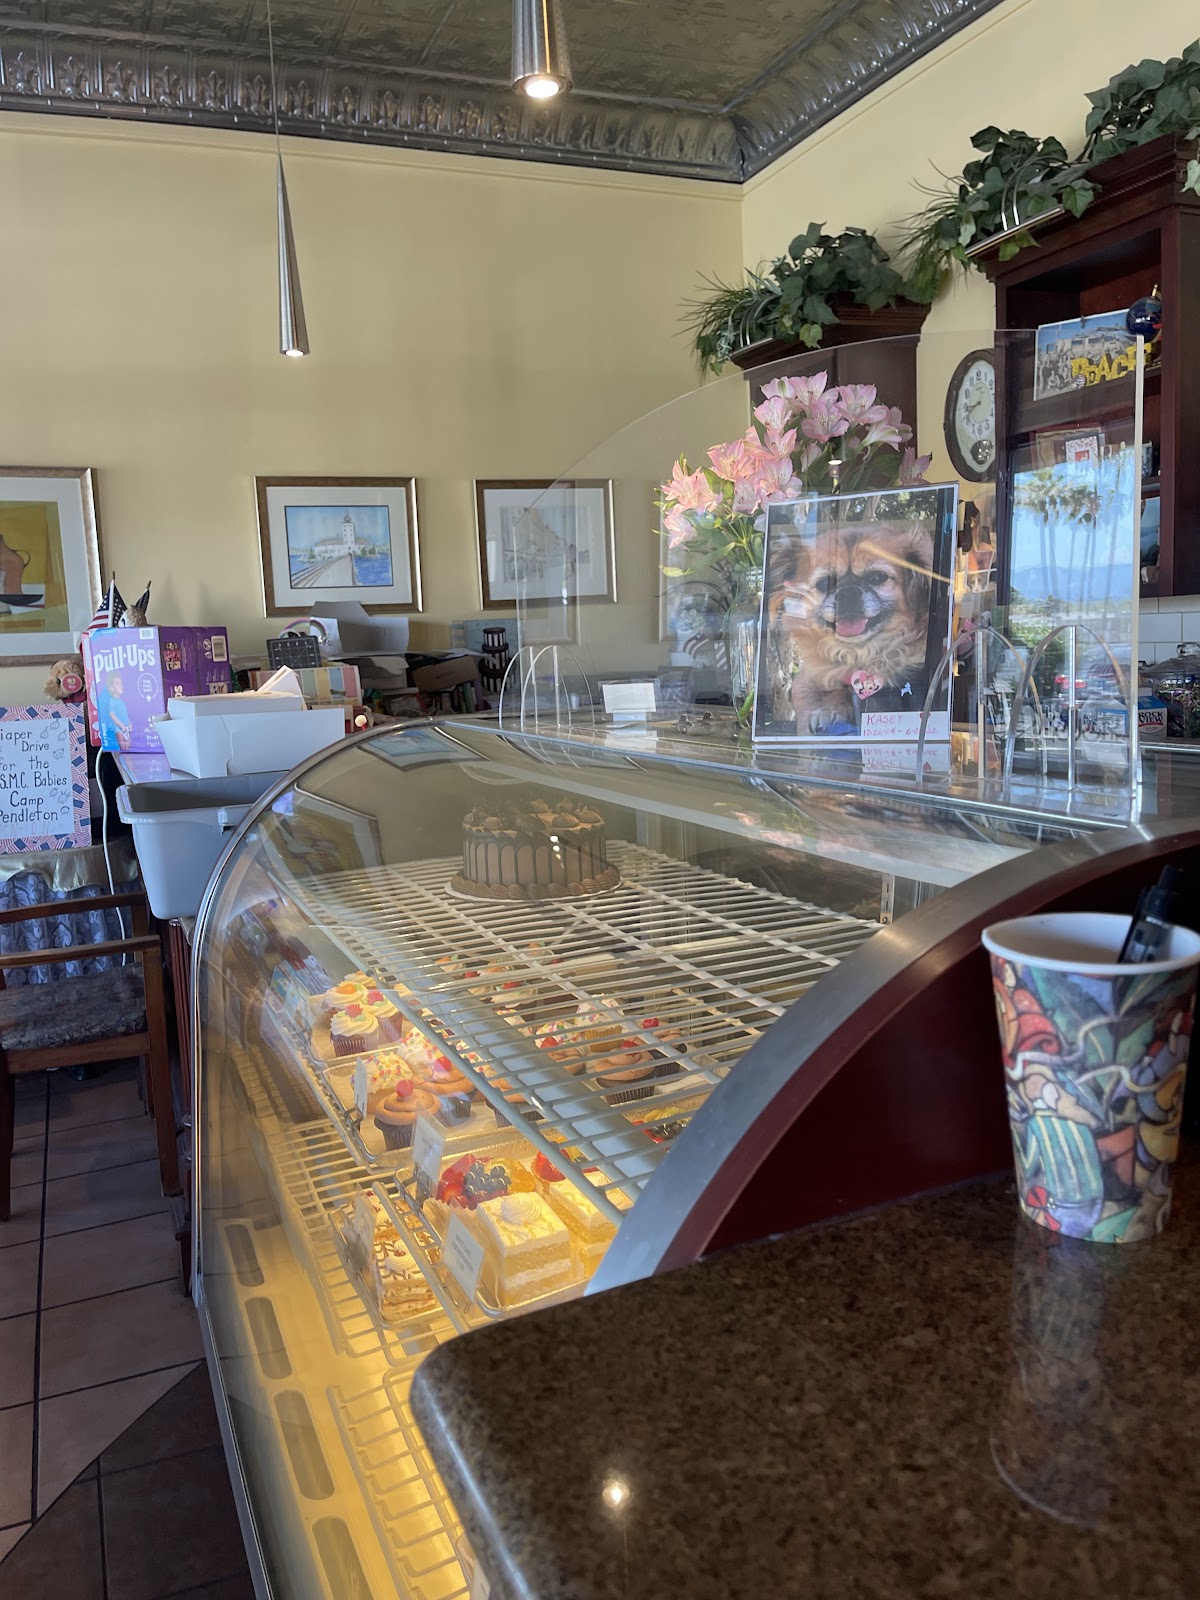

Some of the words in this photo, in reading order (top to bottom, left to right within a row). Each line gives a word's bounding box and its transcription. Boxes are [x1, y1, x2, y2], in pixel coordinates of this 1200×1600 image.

[866, 714, 903, 725] KASEY
[0, 729, 33, 746] iaper
[21, 740, 50, 752] Drive
[28, 755, 50, 770] the
[34, 770, 67, 788] Babies
[10, 790, 44, 809] Camp
